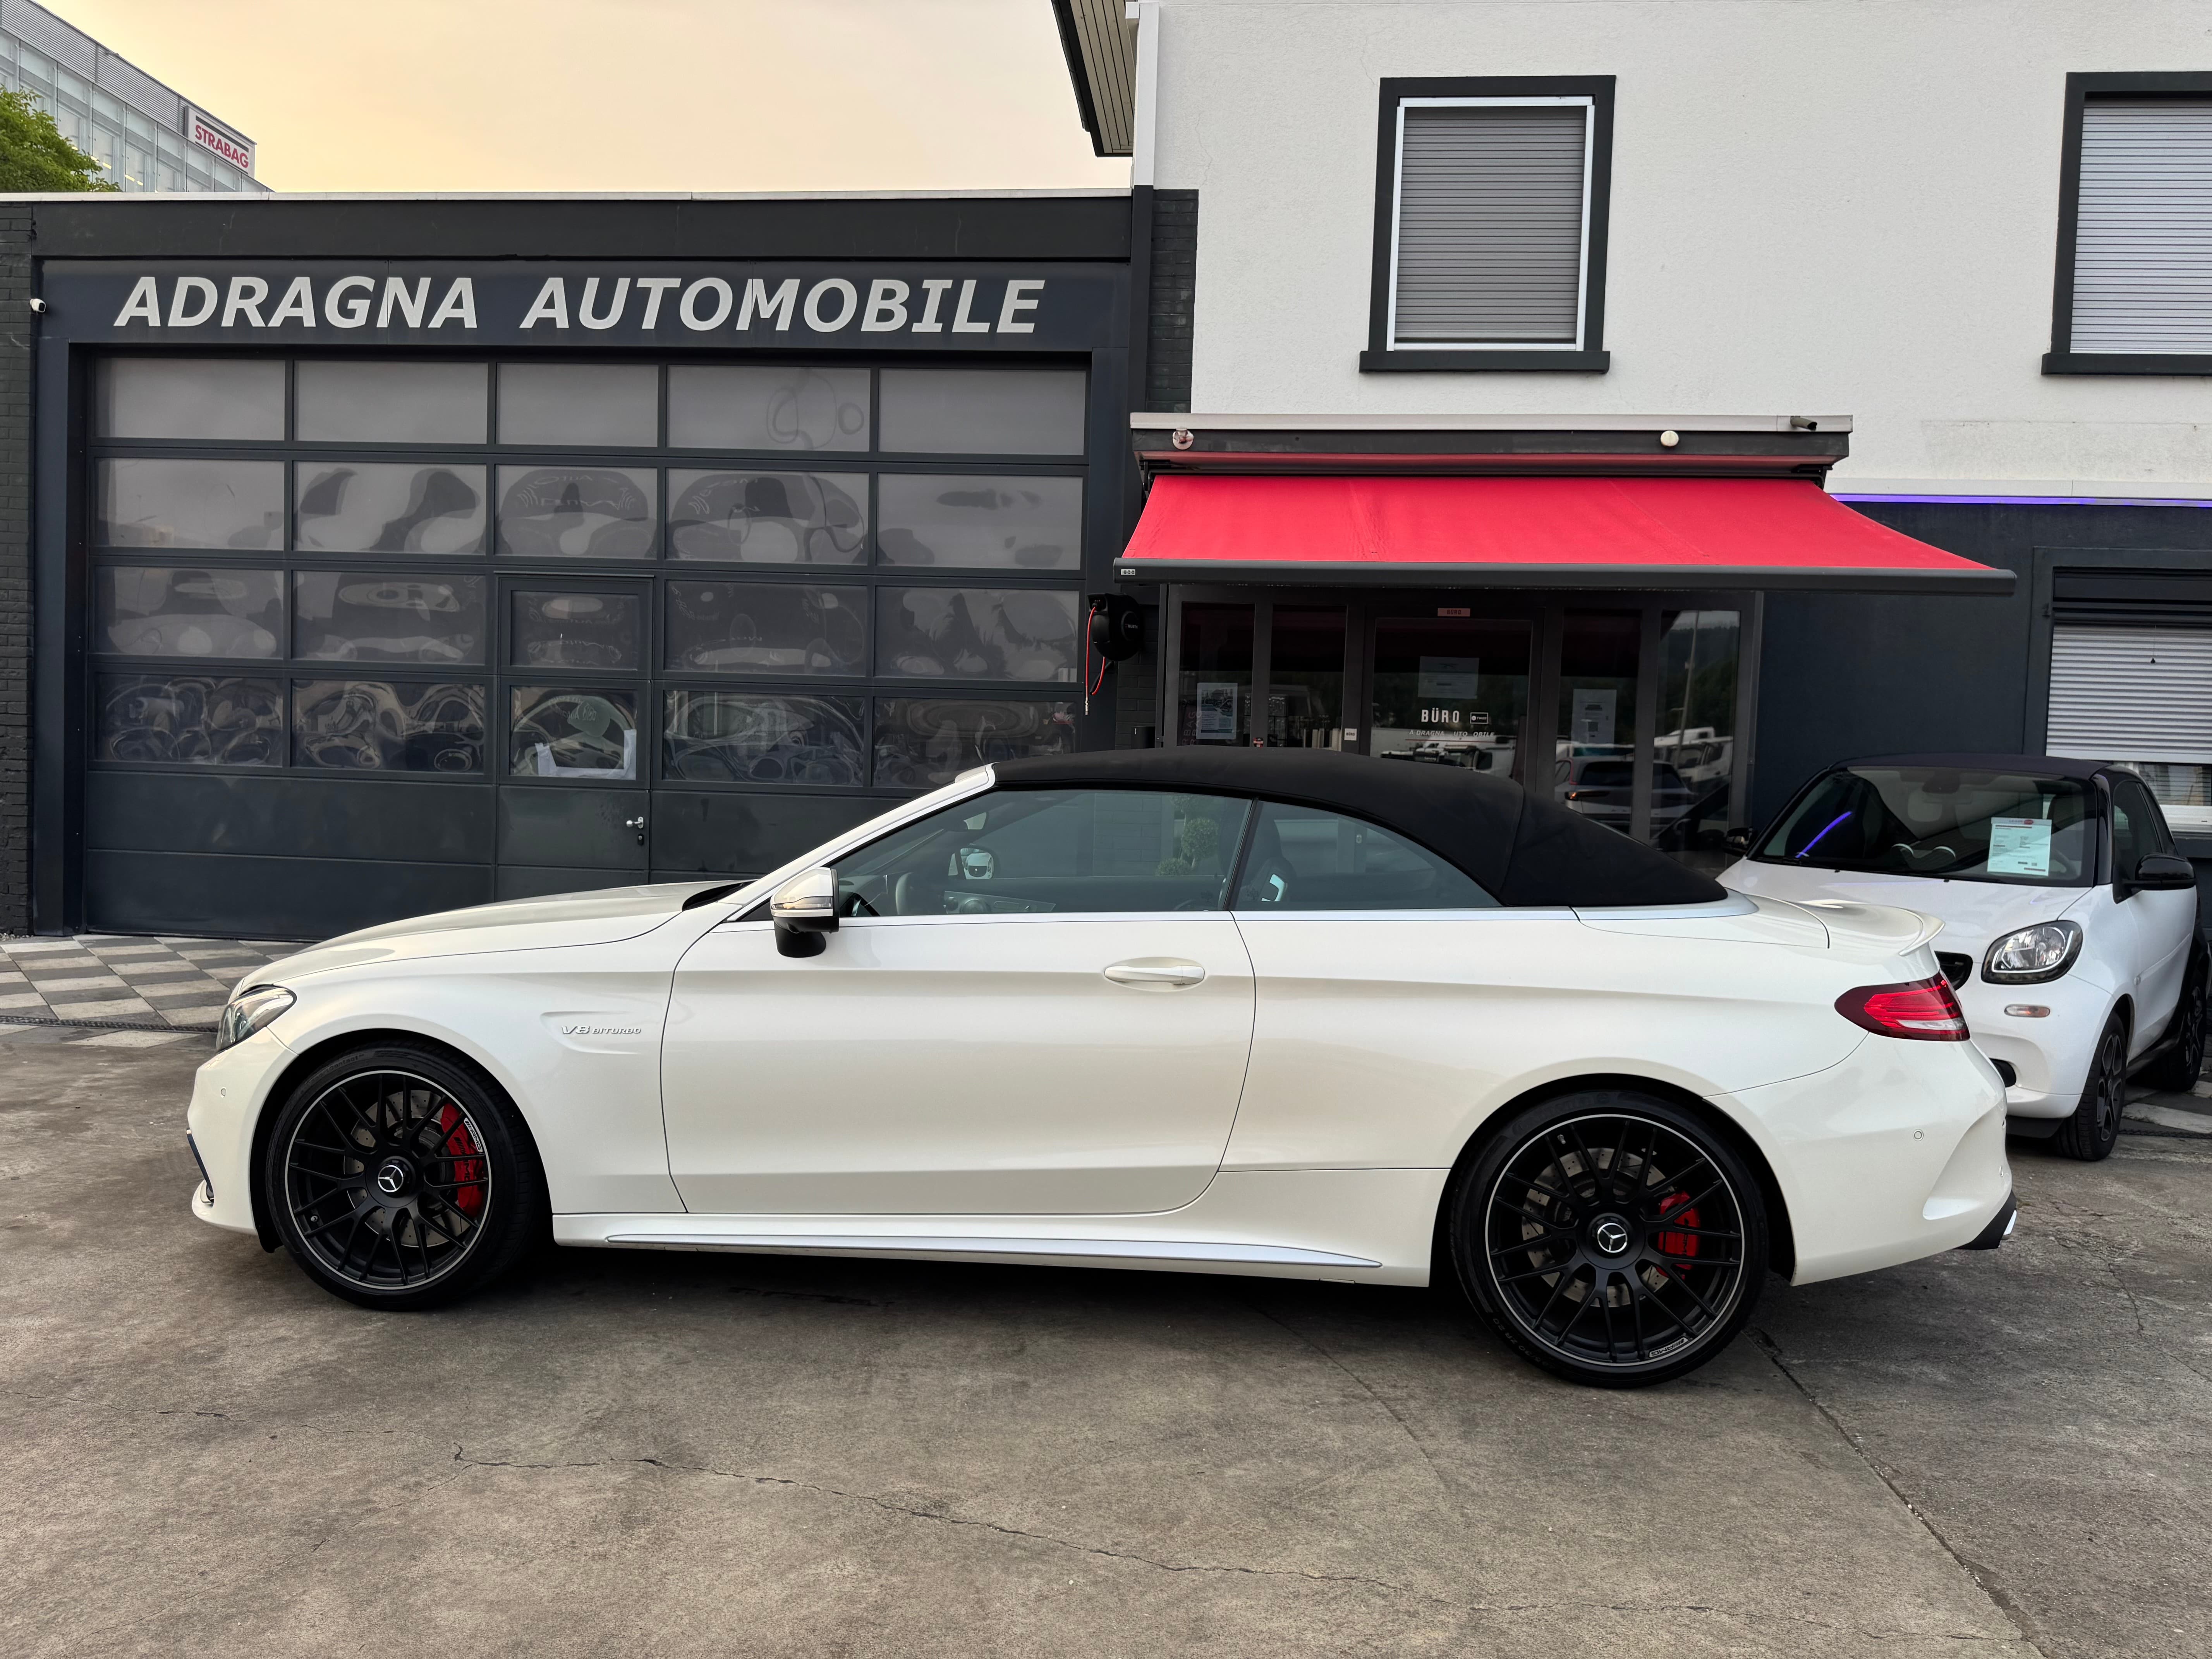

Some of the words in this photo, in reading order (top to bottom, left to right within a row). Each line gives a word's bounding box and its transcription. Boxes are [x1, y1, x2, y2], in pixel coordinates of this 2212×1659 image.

[195, 125, 249, 168] STRABAG
[113, 276, 477, 328] ADRAGNA
[519, 278, 1045, 333] AUTOMOBILE
[1420, 708, 1460, 723] BÜRO
[561, 1025, 590, 1034] V8
